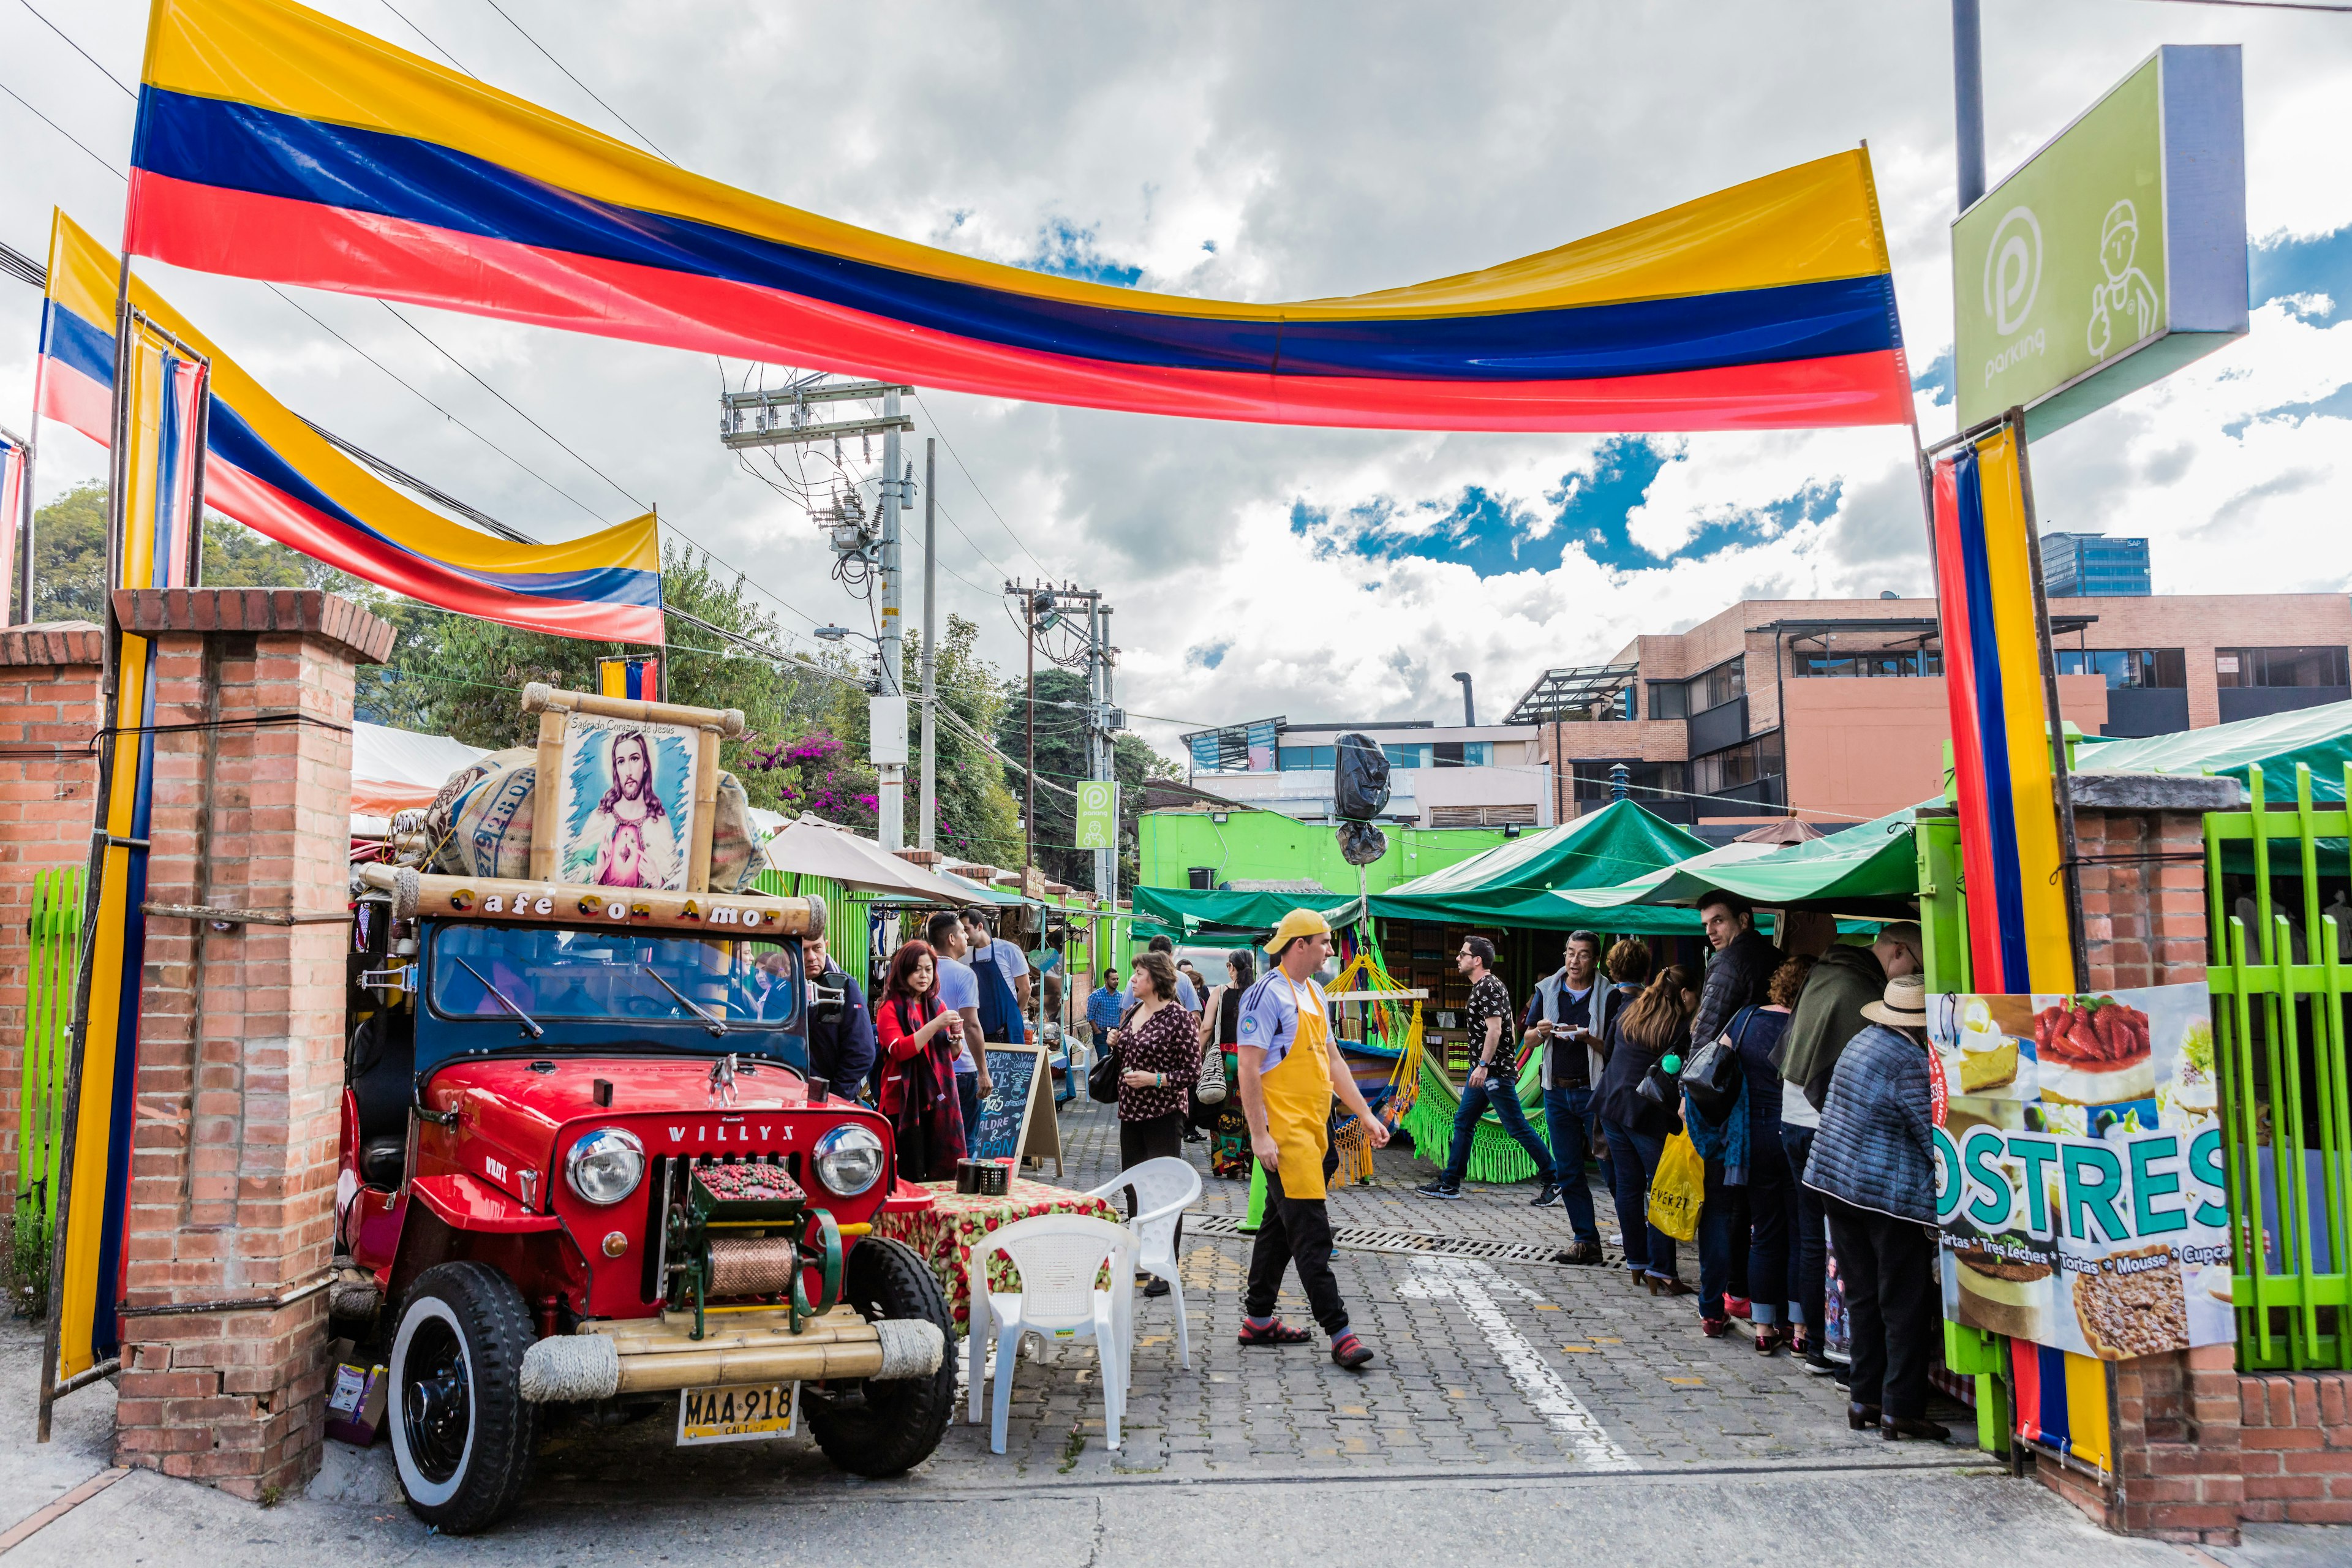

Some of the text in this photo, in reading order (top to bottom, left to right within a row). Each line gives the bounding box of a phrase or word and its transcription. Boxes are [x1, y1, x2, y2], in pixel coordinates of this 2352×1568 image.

[1985, 327, 2046, 389] parking
[571, 717, 675, 734] Sagrado Corazón de Jesús
[578, 894, 650, 921] Con
[676, 899, 781, 927] Amor
[1934, 1061, 1940, 1074] DE
[668, 1126, 794, 1142] WILLYS
[981, 1136, 1015, 1157] PAN
[1940, 1230, 1970, 1249] Tartas
[1980, 1237, 2005, 1256] Tres
[2007, 1243, 2048, 1264] Leches
[2059, 1251, 2100, 1276] Tortas
[2115, 1254, 2168, 1275] Mousse
[685, 1387, 792, 1427] MAA 918
[725, 1425, 749, 1435] CALI
